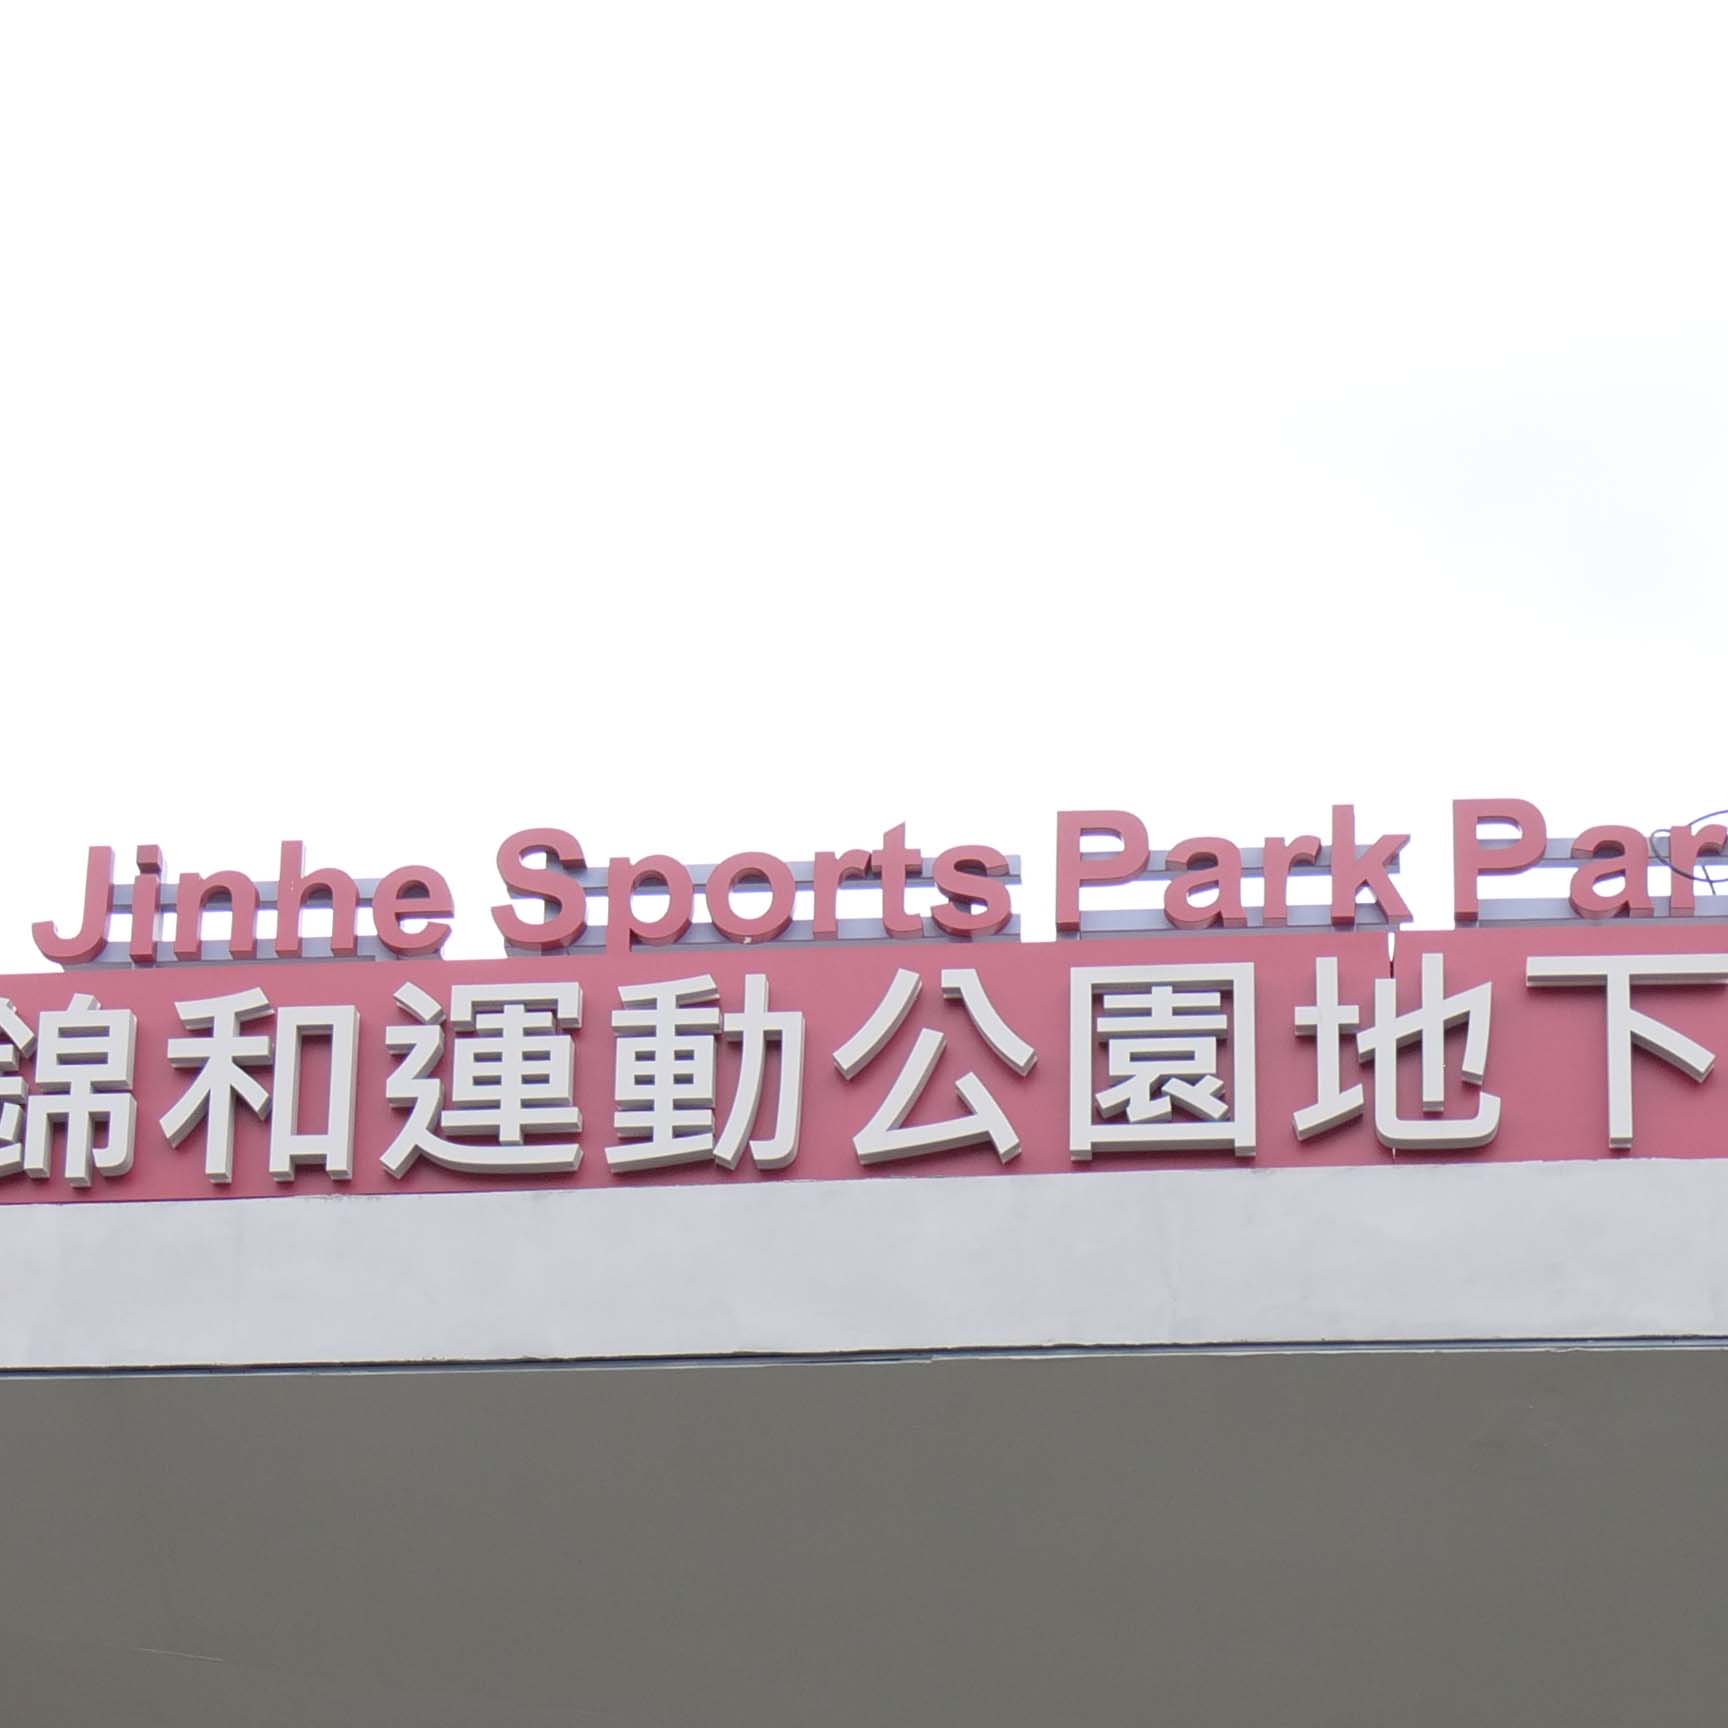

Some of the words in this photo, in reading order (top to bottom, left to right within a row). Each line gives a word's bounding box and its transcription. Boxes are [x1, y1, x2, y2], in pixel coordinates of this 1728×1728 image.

[32, 839, 455, 963] Jinhe
[491, 821, 1013, 956] Sports
[1056, 804, 1412, 936] Park
